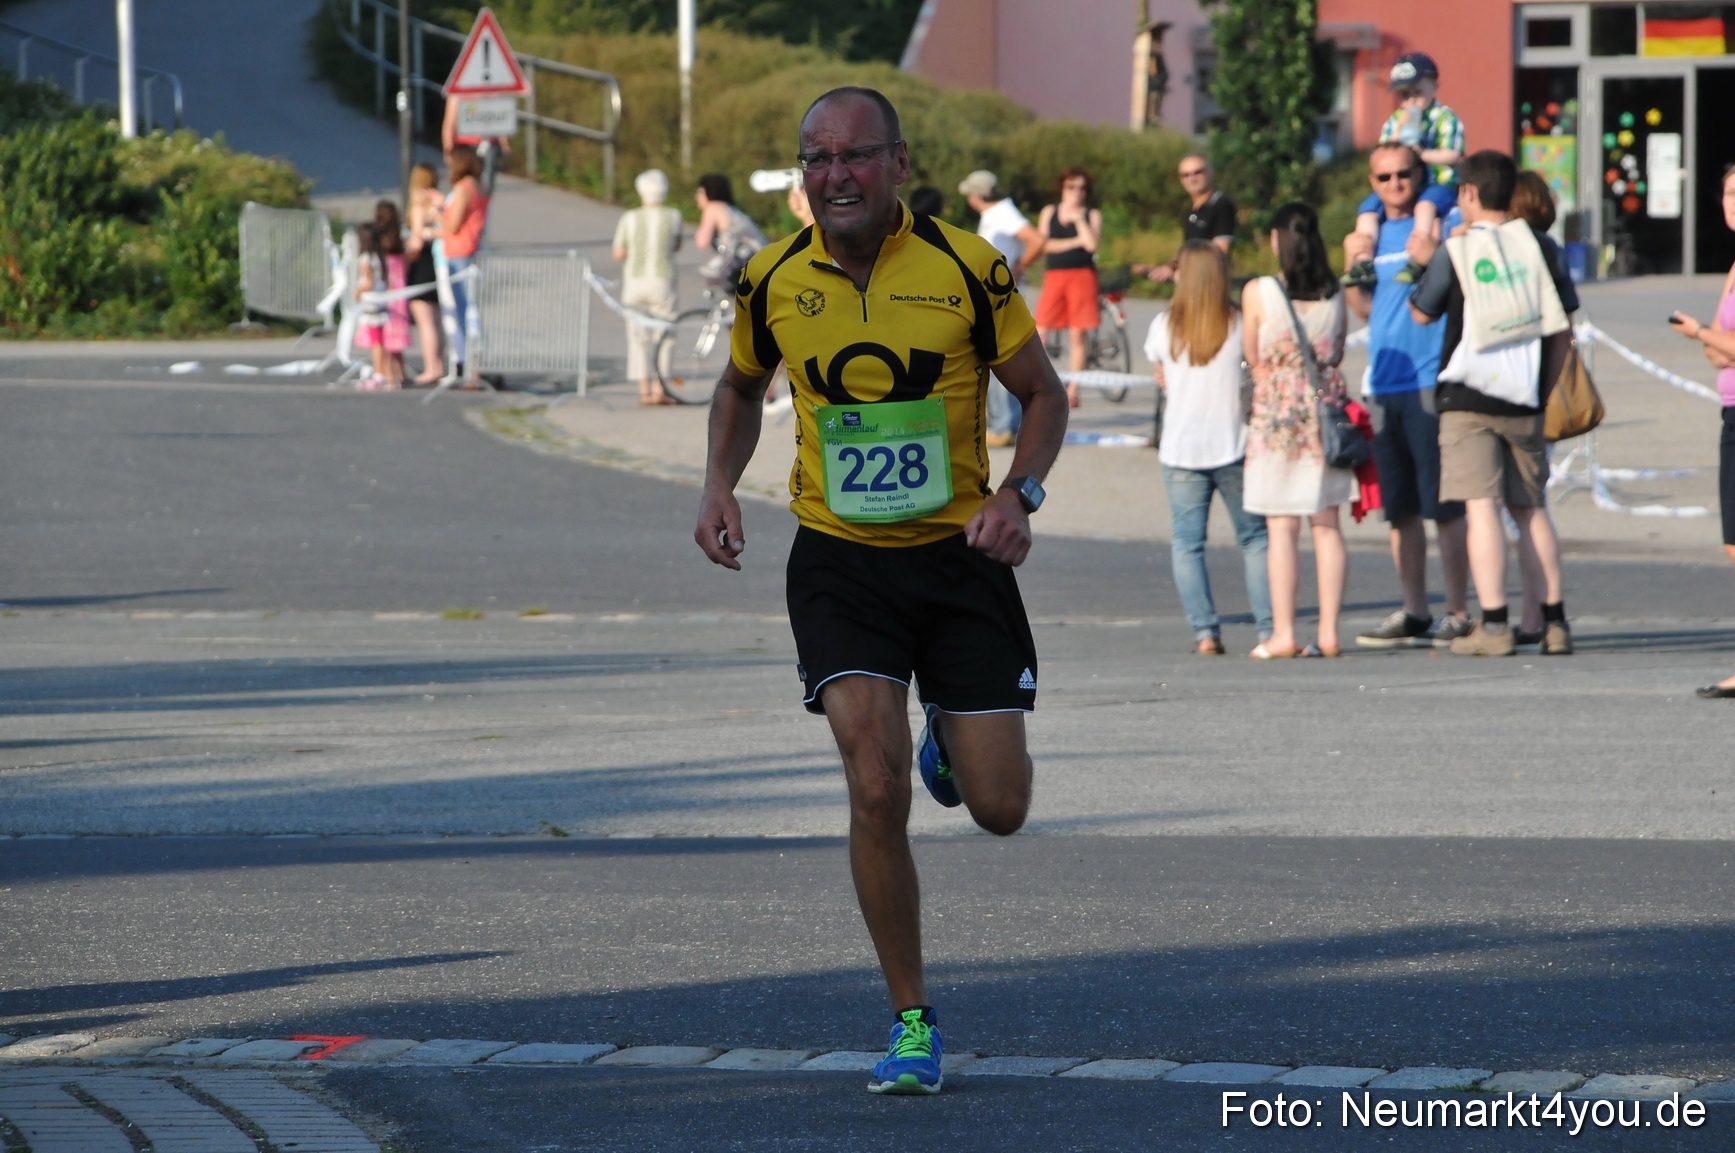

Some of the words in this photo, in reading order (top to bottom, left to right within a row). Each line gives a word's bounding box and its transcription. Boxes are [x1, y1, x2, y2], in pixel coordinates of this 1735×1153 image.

[889, 294, 927, 302] Deutsche
[928, 295, 945, 304] Post
[836, 422, 879, 433] firmenlauf
[837, 443, 929, 492] 228
[864, 494, 886, 503] Stefan
[886, 493, 910, 502] Reindl
[860, 505, 888, 513] Deutsche
[889, 504, 904, 512] Post
[905, 502, 916, 510] AG
